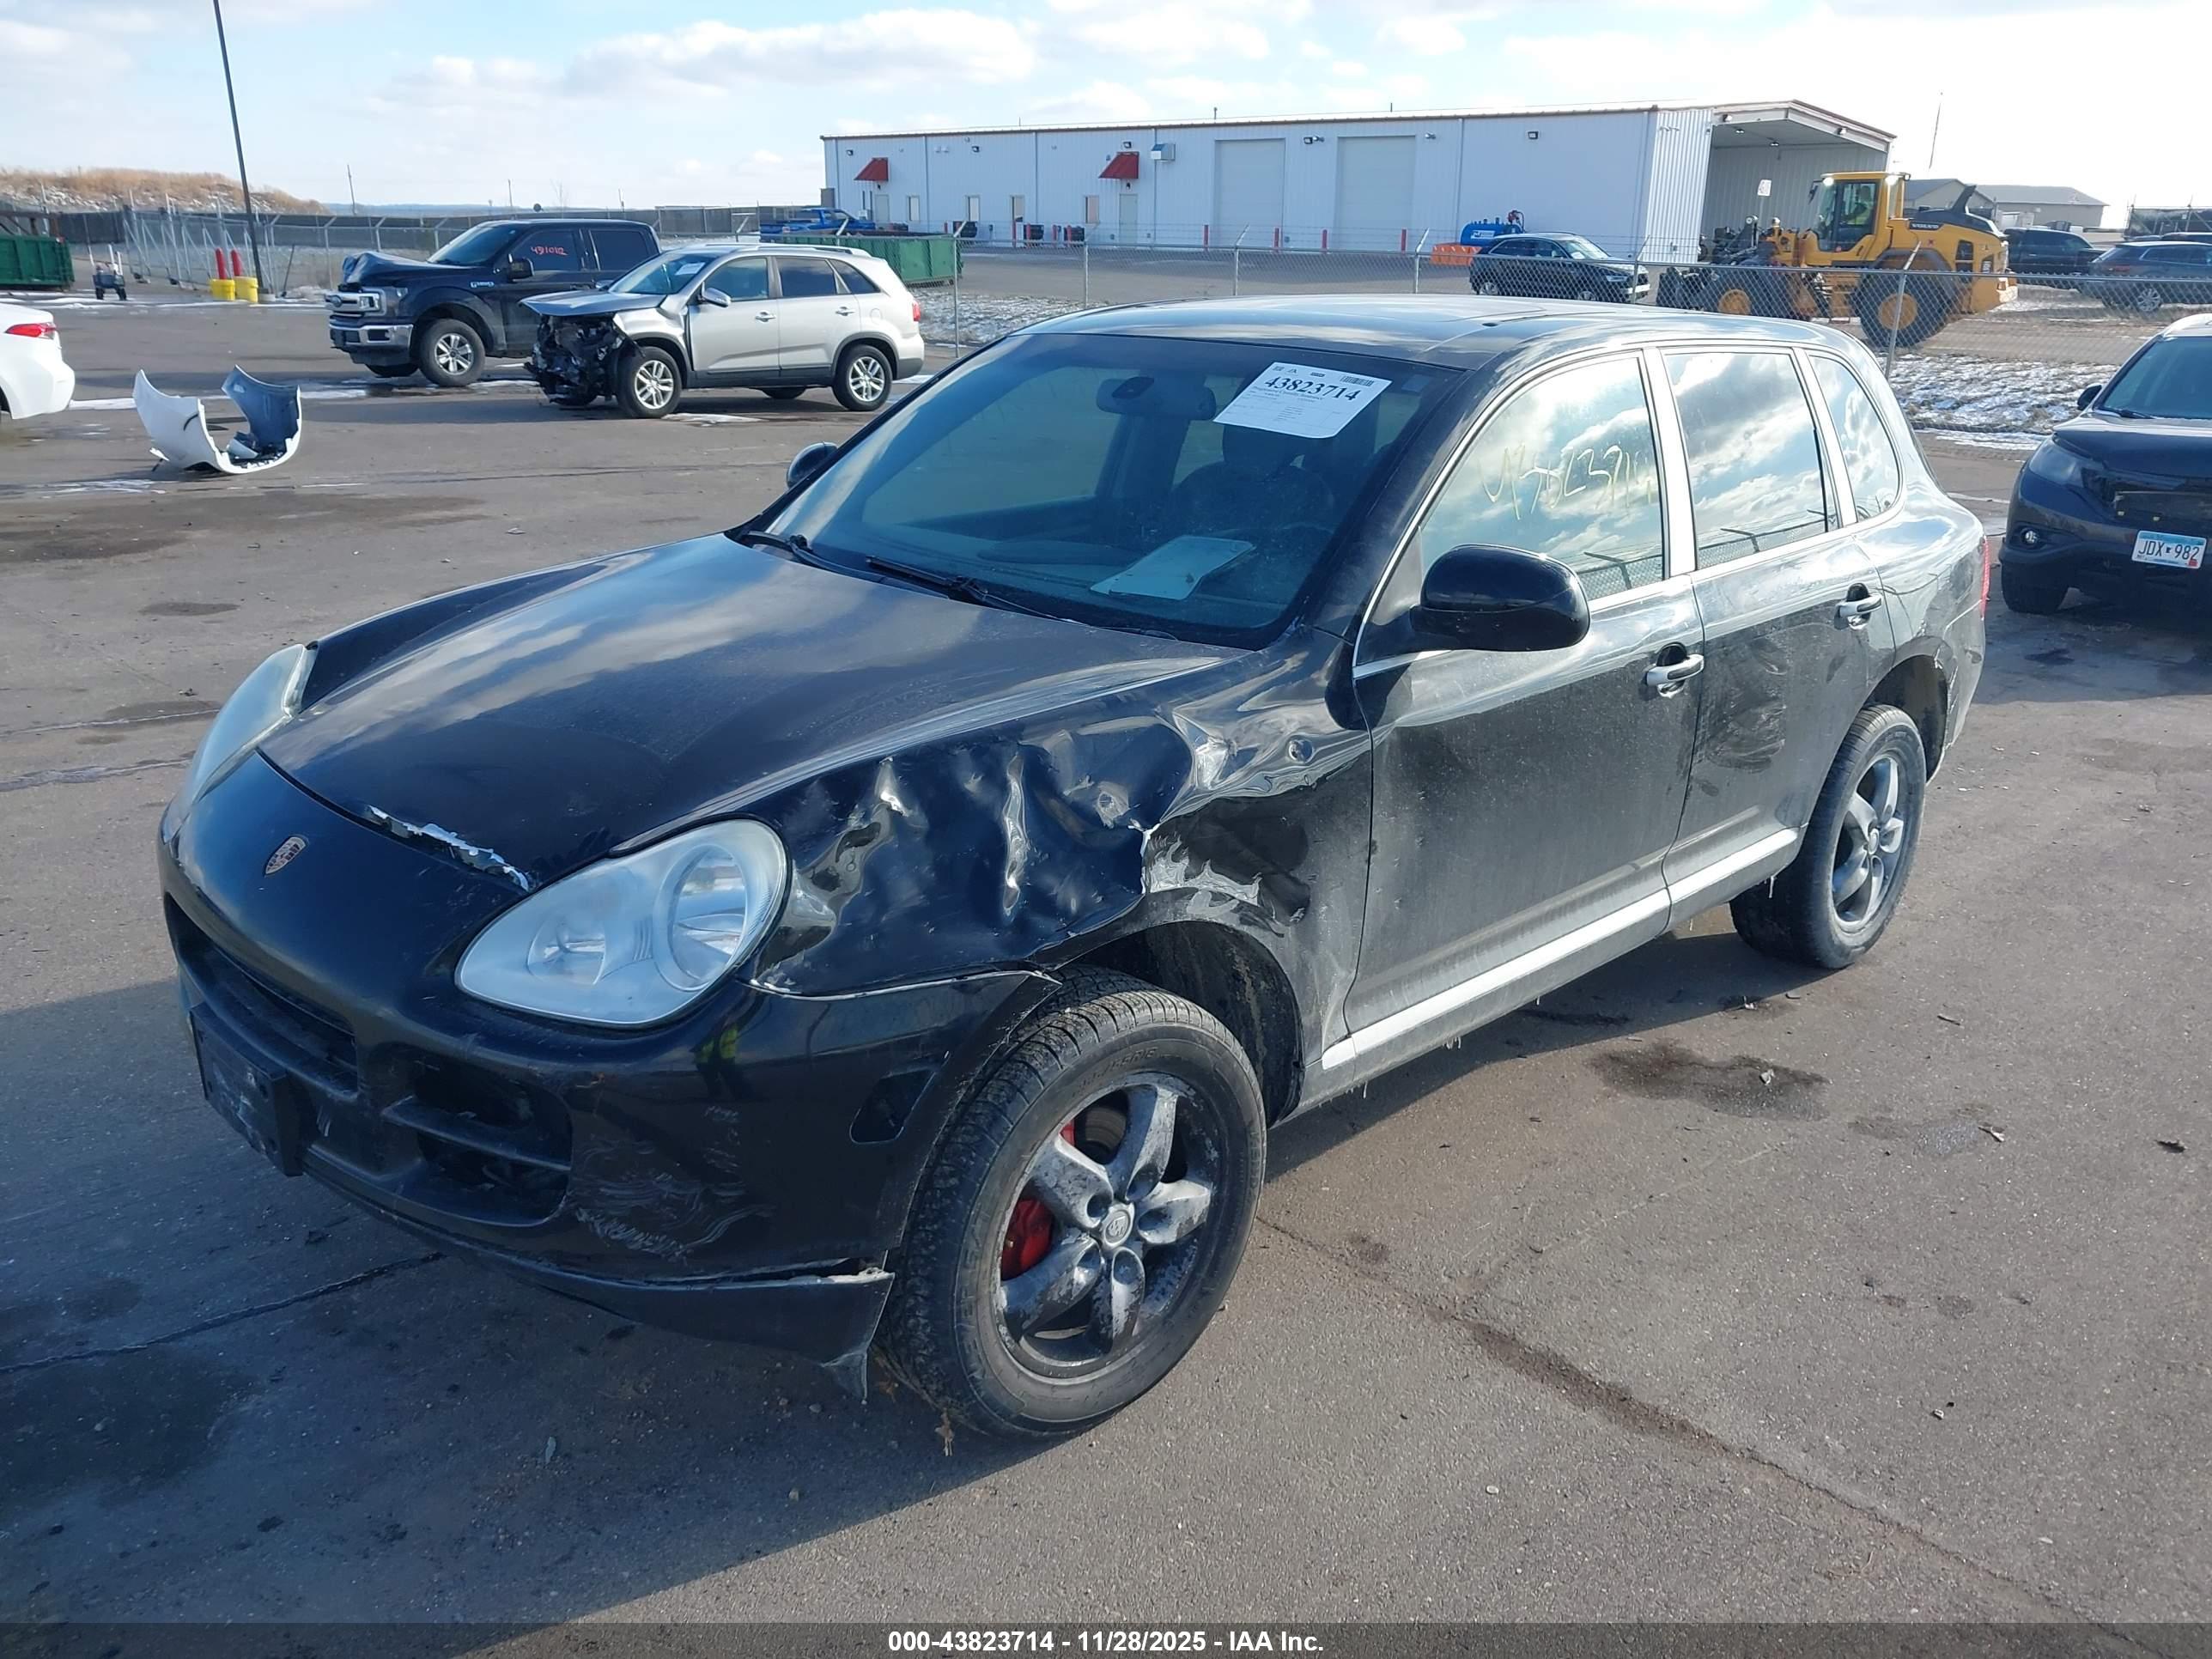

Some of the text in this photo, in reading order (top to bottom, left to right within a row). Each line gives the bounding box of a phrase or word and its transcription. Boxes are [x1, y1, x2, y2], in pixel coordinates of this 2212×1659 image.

[1264, 375, 1362, 401] 43823714
[2138, 540, 2165, 556] JDX
[2174, 544, 2200, 561] 982
